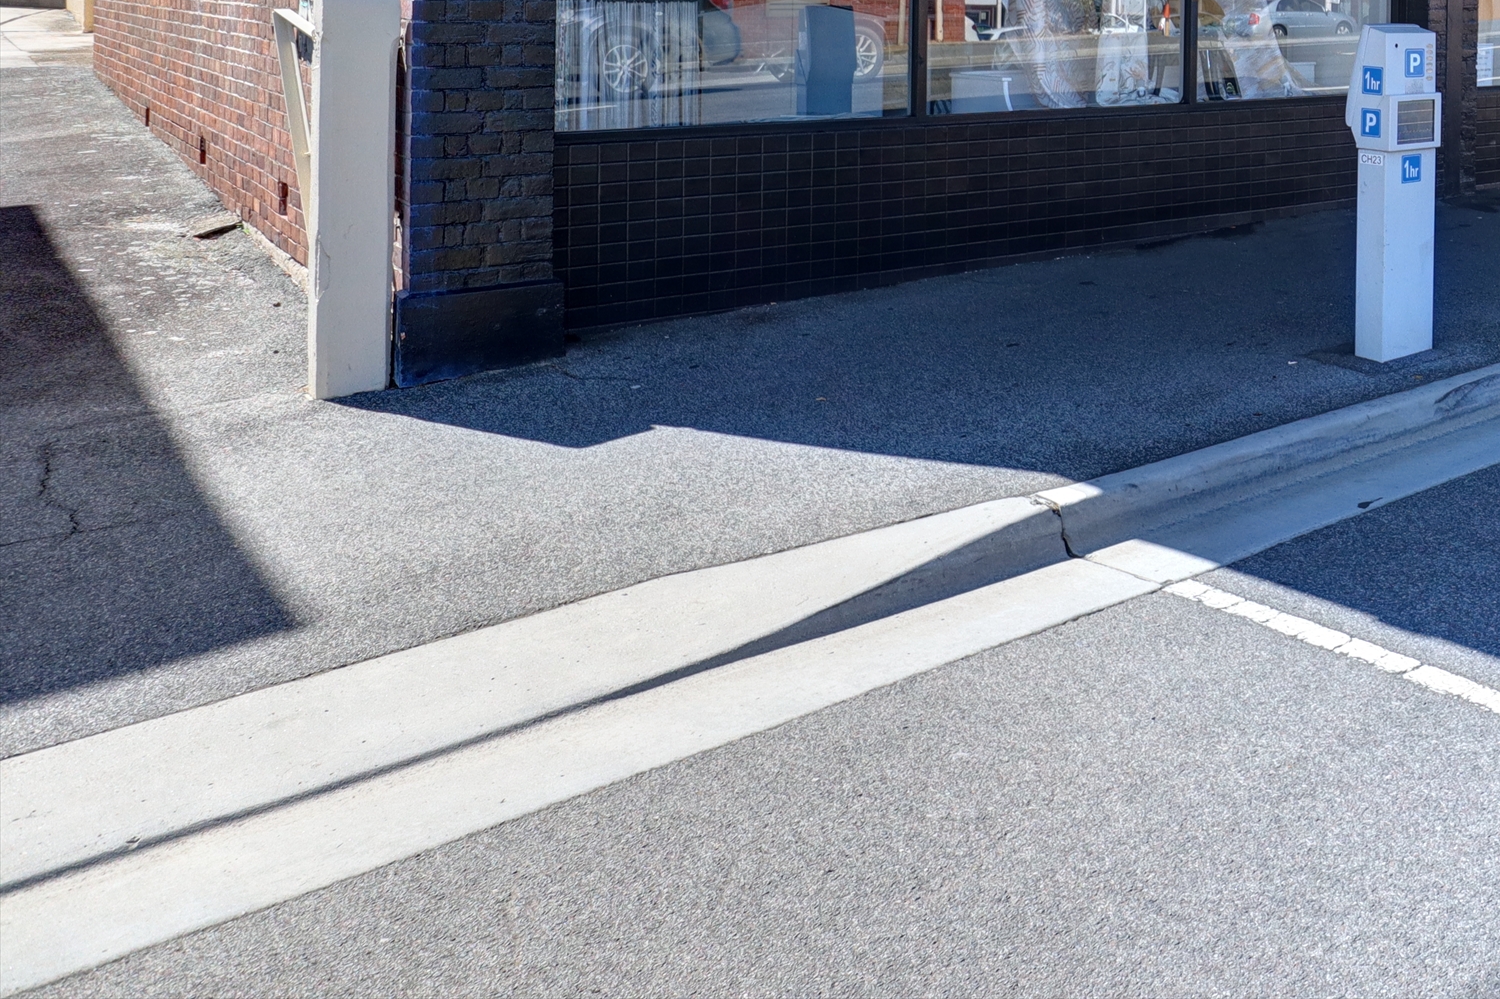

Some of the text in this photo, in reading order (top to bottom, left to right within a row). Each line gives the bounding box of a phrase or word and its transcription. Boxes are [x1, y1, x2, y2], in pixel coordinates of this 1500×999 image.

[1409, 53, 1421, 74] P
[1364, 71, 1381, 91] 1hr
[1365, 112, 1377, 133] P
[1360, 154, 1382, 165] CH23
[1403, 160, 1420, 179] 1hr
